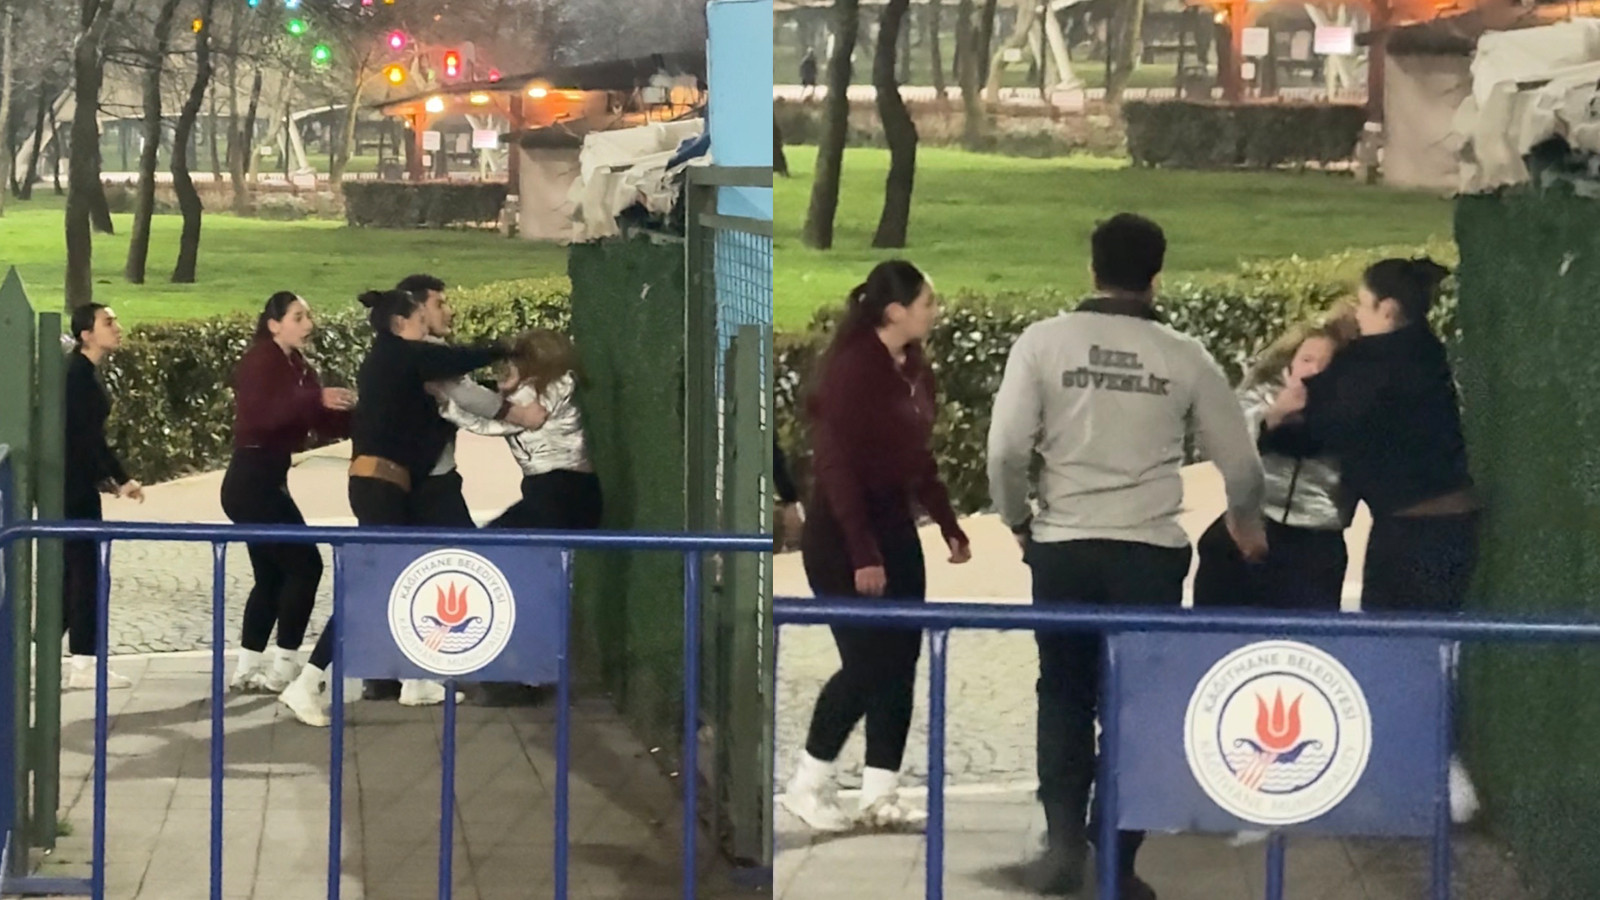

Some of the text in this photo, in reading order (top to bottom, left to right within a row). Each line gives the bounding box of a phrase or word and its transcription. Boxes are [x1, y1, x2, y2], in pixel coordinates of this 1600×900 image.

[1089, 345, 1143, 369] ÖZEL
[1062, 367, 1170, 395] GÜVENLİK
[401, 557, 453, 600] KAĞITHANE
[1203, 652, 1360, 720] KAĞITHANE BELEDİYESİ
